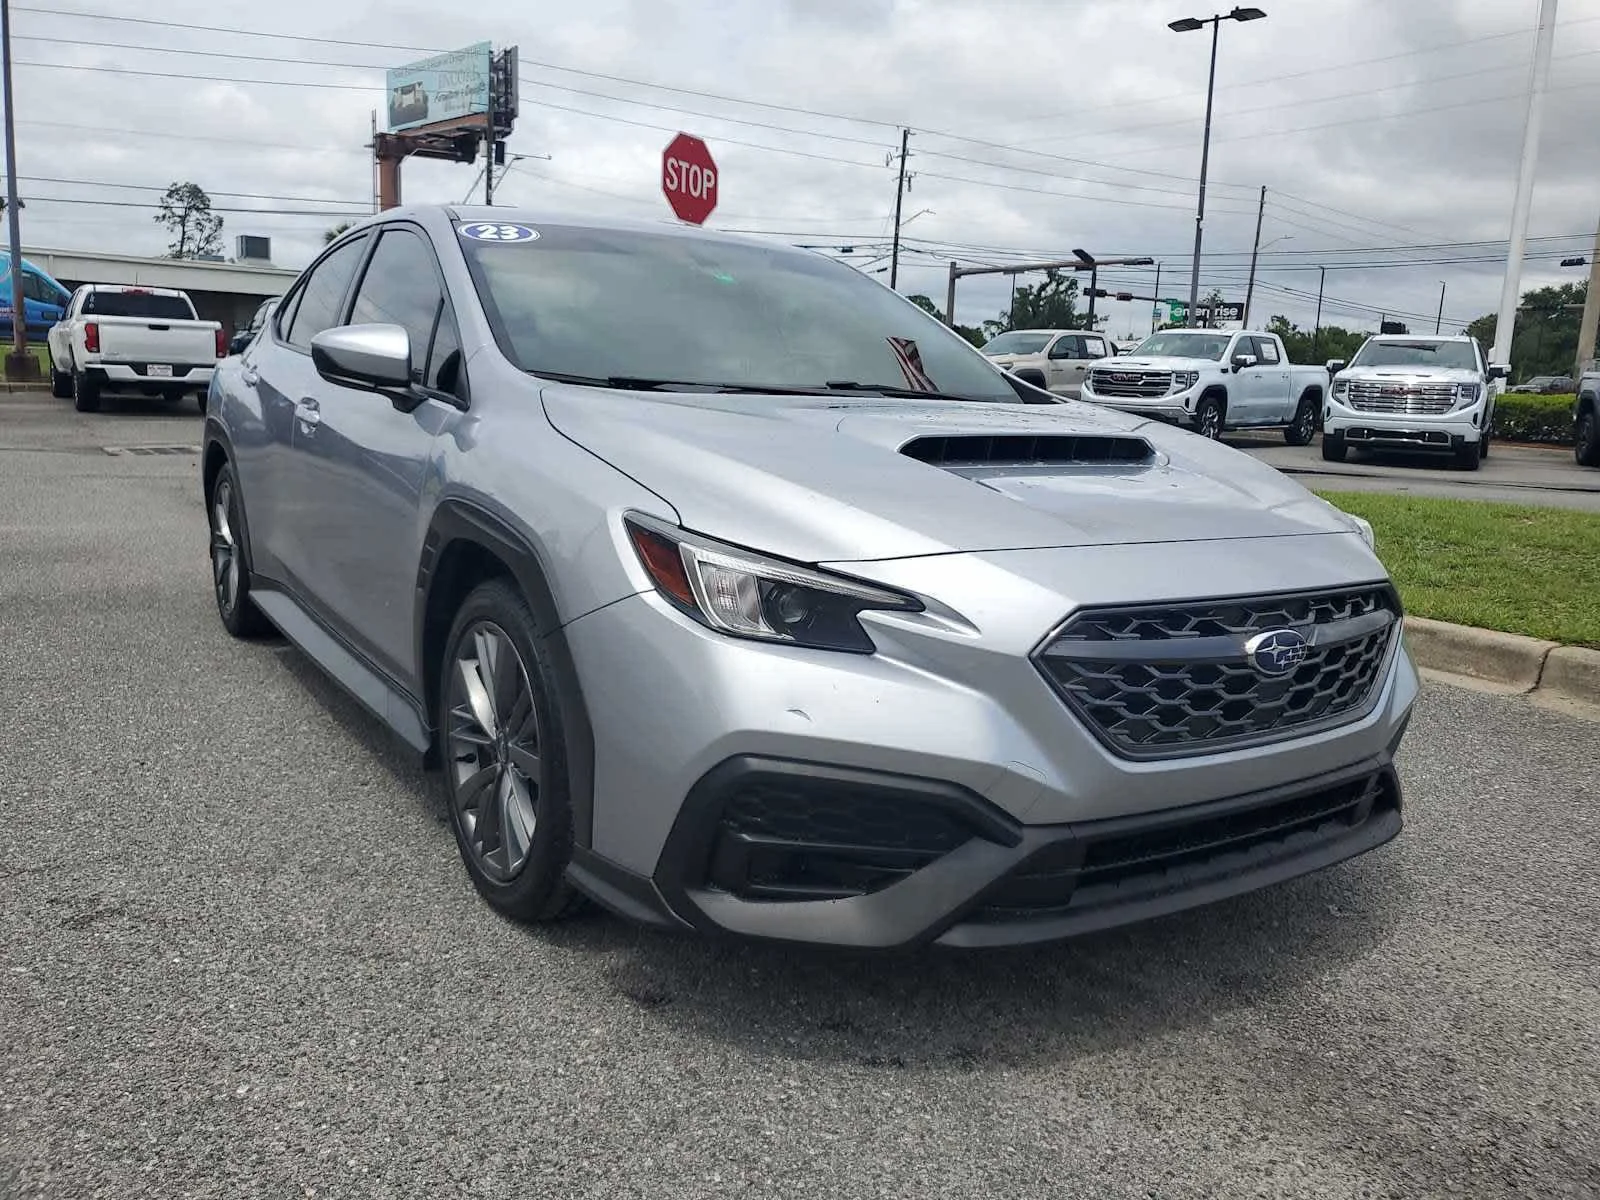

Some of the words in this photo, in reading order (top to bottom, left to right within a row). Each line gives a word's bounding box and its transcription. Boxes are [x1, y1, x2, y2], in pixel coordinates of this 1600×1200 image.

[665, 157, 715, 200] STOP
[475, 224, 520, 240] 23
[1172, 305, 1238, 319] enerrise
[1112, 373, 1141, 381] GMC
